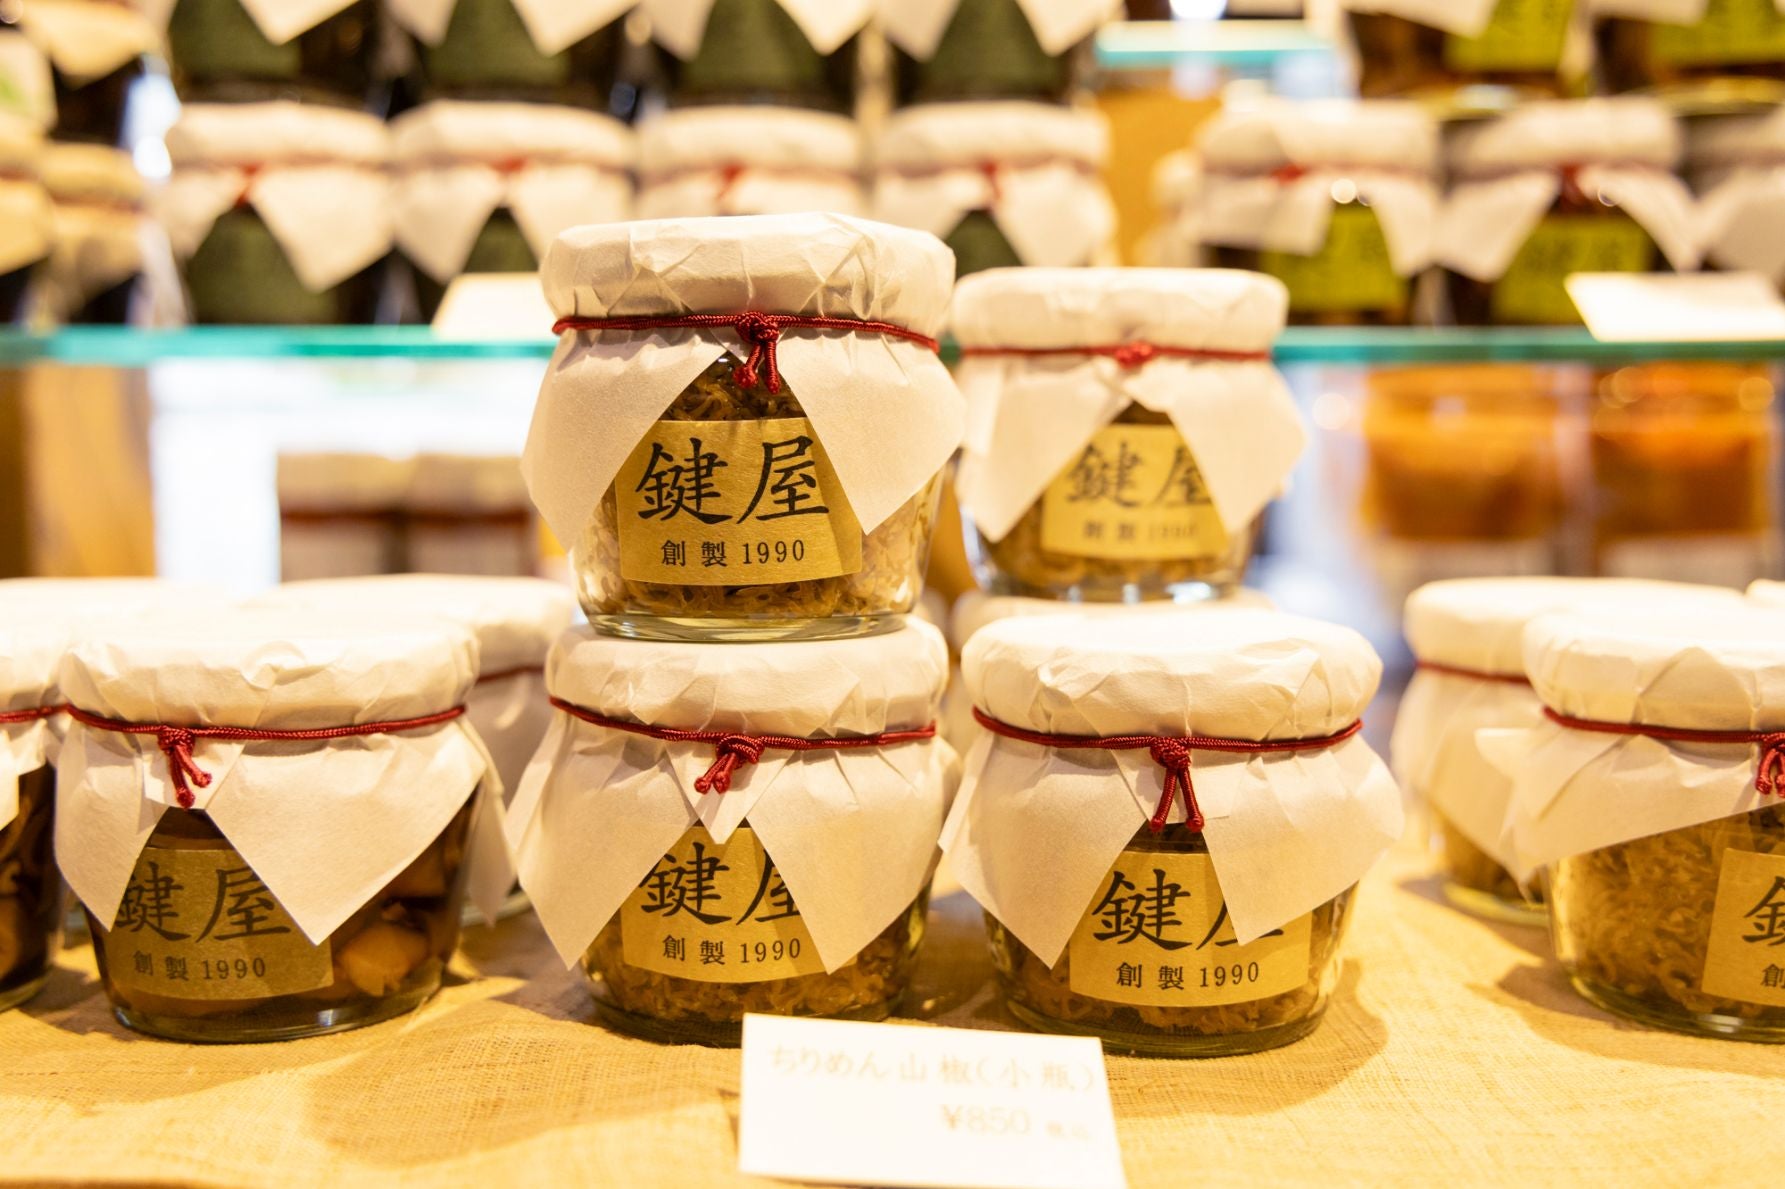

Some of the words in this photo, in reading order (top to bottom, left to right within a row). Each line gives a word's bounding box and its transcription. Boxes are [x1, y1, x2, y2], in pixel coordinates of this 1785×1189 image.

[634, 435, 829, 524] 鍵屋
[661, 540, 727, 567] 創製
[742, 540, 805, 564] 1990
[115, 861, 291, 943] 鍵屋
[1091, 868, 1284, 950] 鍵
[662, 934, 725, 965] 創製
[740, 938, 801, 963] 1990
[133, 950, 189, 981] 創製
[202, 957, 267, 980] 1990
[1116, 962, 1184, 990] 創製
[1200, 961, 1259, 987] 1990
